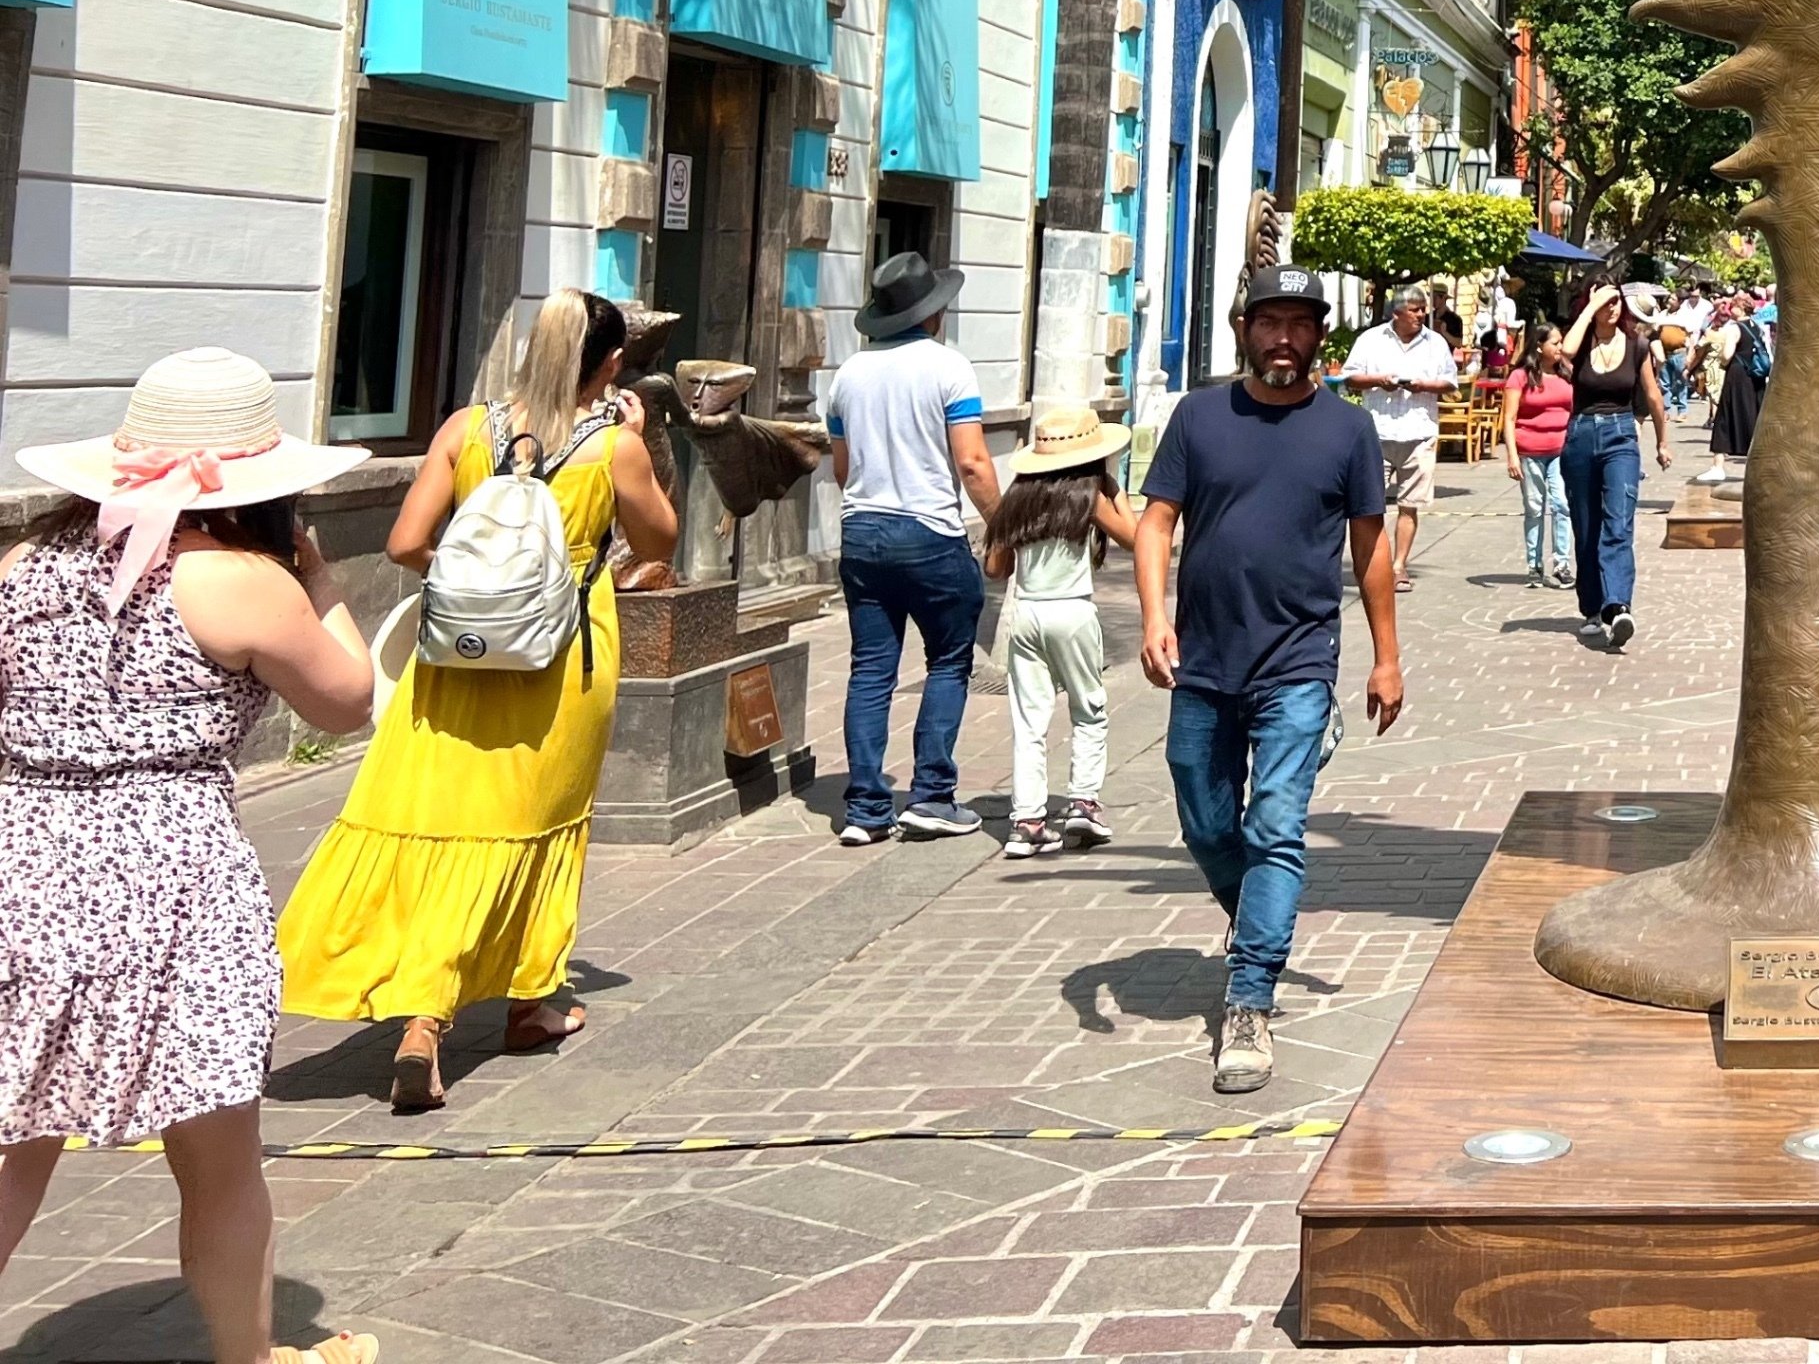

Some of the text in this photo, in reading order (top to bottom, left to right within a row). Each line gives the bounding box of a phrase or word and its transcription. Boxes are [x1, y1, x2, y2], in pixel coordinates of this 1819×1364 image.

[486, 0, 553, 32] BUSTAMANTE
[1282, 271, 1306, 283] NEO
[1281, 282, 1306, 293] CITY
[1740, 949, 1798, 963] Sergio
[1750, 965, 1774, 980] El
[1732, 1015, 1778, 1026] Sergio
